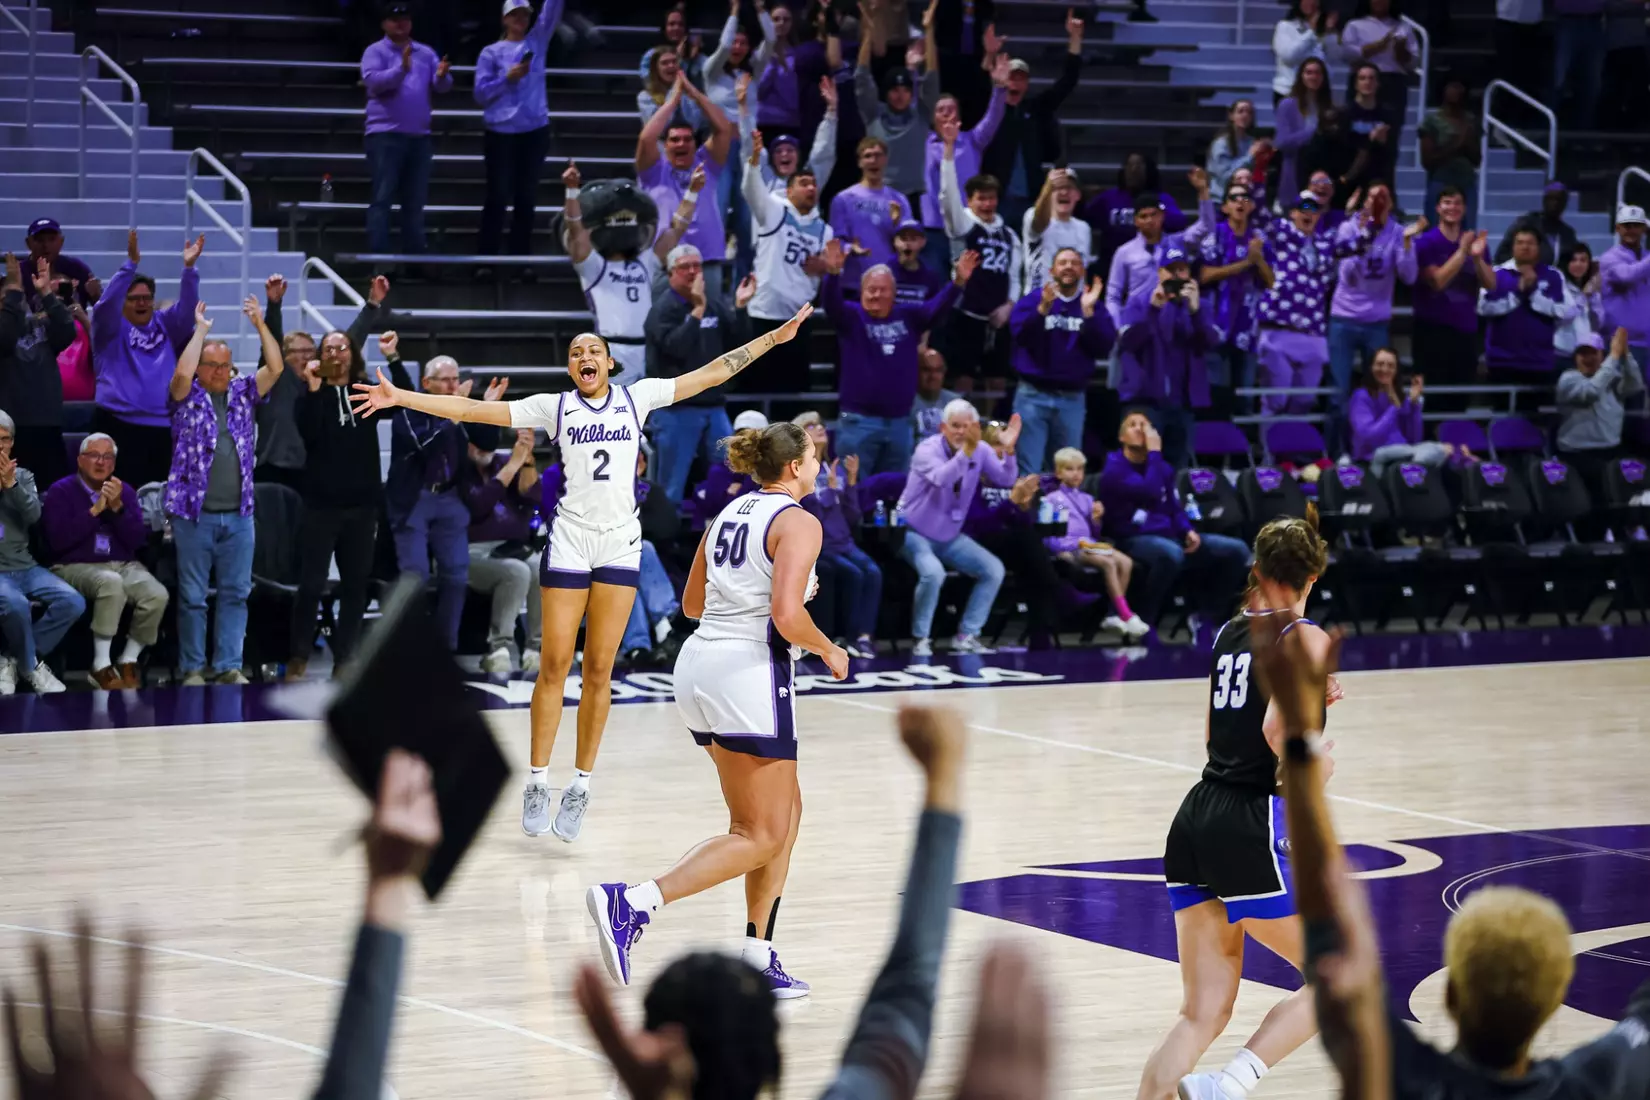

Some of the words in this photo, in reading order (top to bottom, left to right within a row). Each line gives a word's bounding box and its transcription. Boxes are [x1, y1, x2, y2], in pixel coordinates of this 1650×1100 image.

[566, 423, 632, 446] Wildcats
[592, 448, 611, 482] 2
[736, 498, 761, 515] LEE
[713, 521, 750, 569] 50
[1213, 652, 1252, 710] 33
